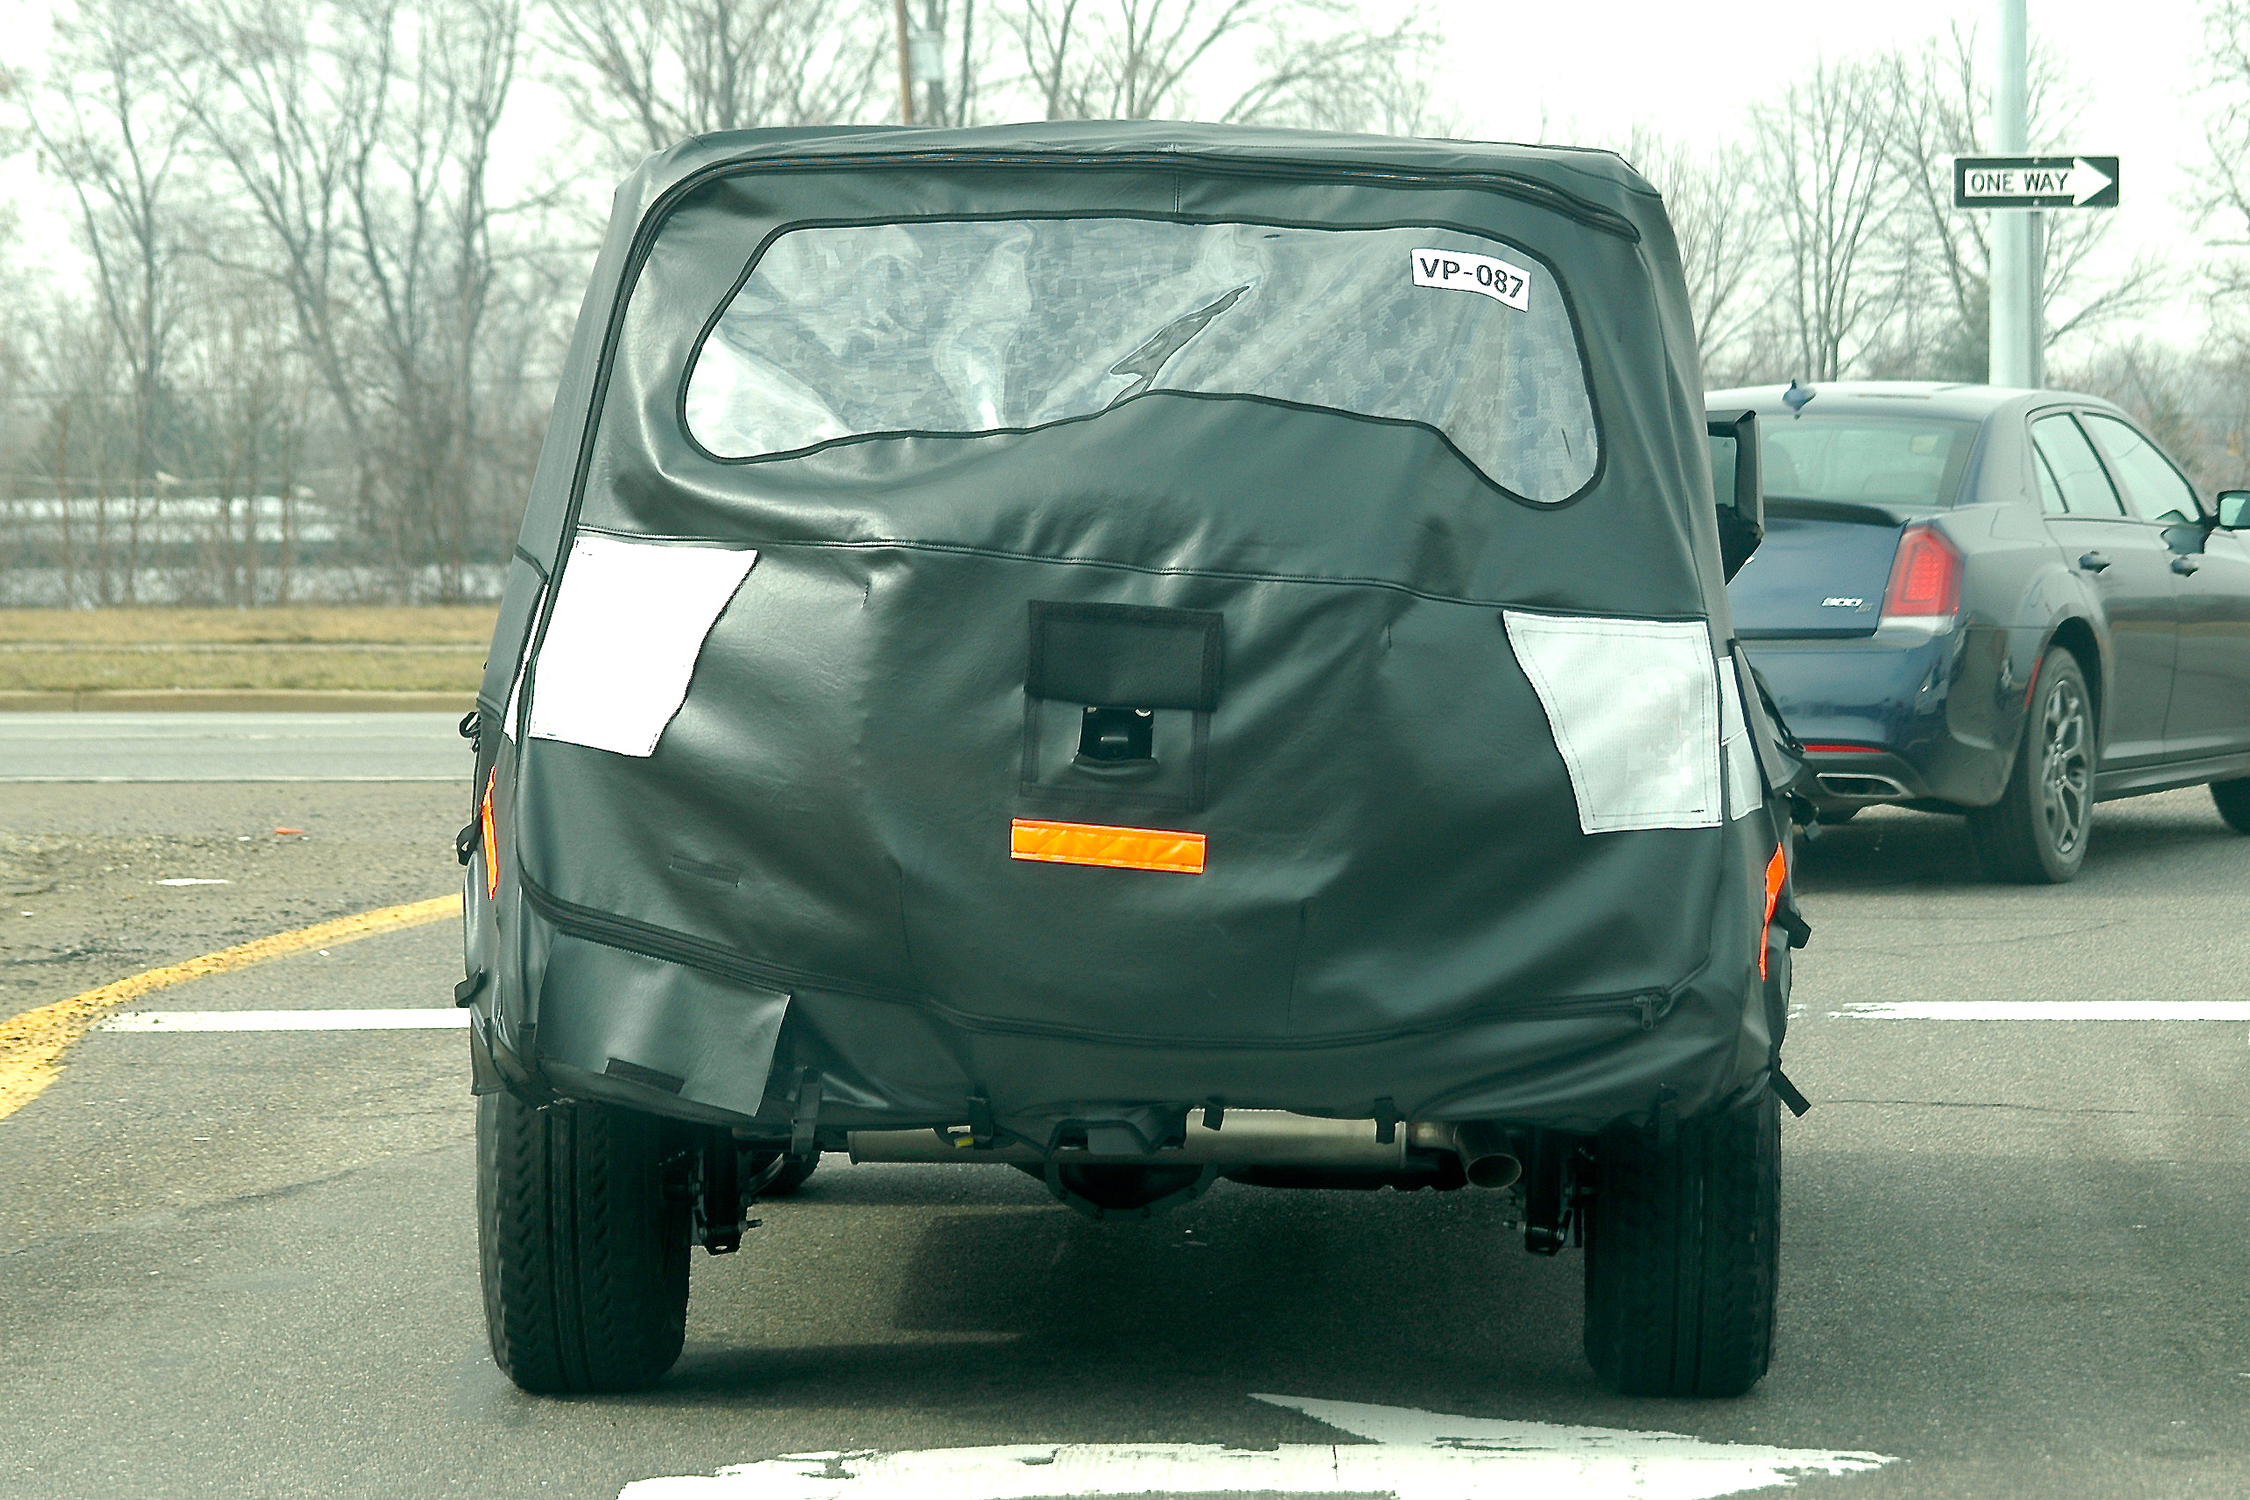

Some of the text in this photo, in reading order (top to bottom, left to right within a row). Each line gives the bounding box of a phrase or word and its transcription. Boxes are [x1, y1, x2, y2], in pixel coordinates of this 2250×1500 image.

[1971, 173, 2068, 193] ONE WAY
[1420, 258, 1523, 298] VP-087
